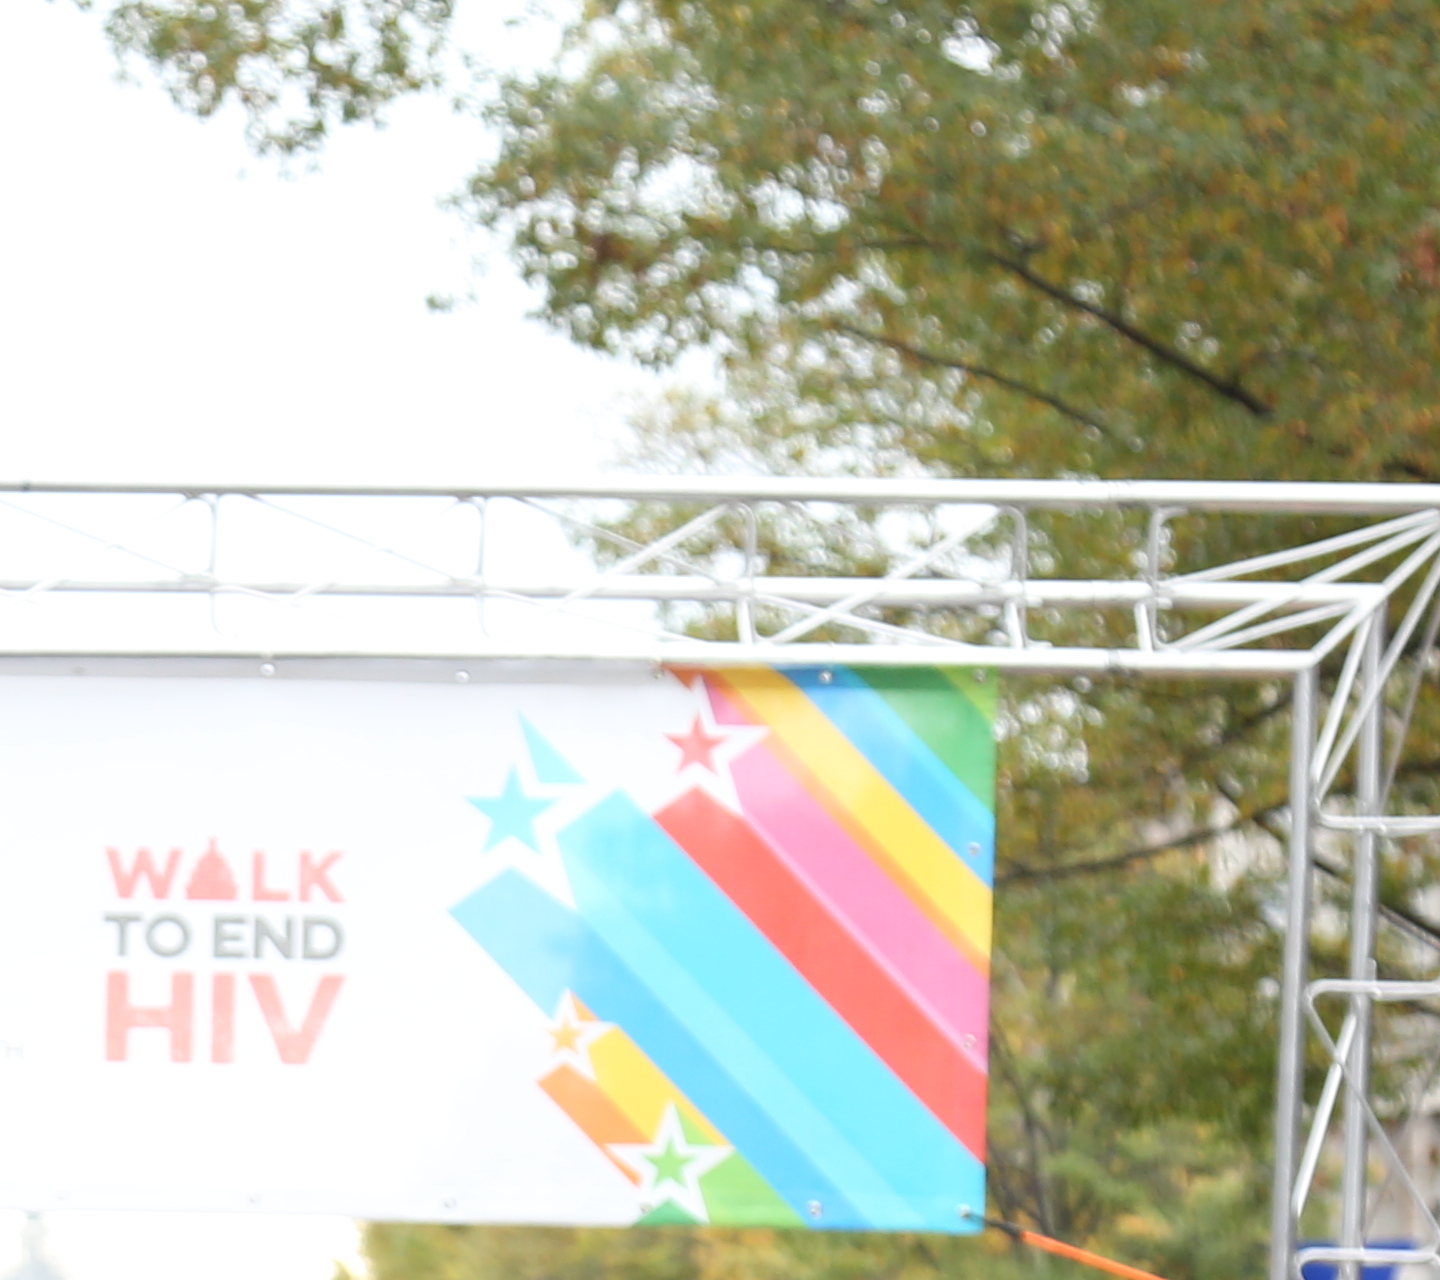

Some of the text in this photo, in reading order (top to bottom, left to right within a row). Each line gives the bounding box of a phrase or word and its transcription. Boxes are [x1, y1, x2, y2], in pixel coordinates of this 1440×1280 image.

[104, 840, 345, 904] WALK
[104, 913, 345, 962] TO END
[104, 970, 346, 1066] HIV
